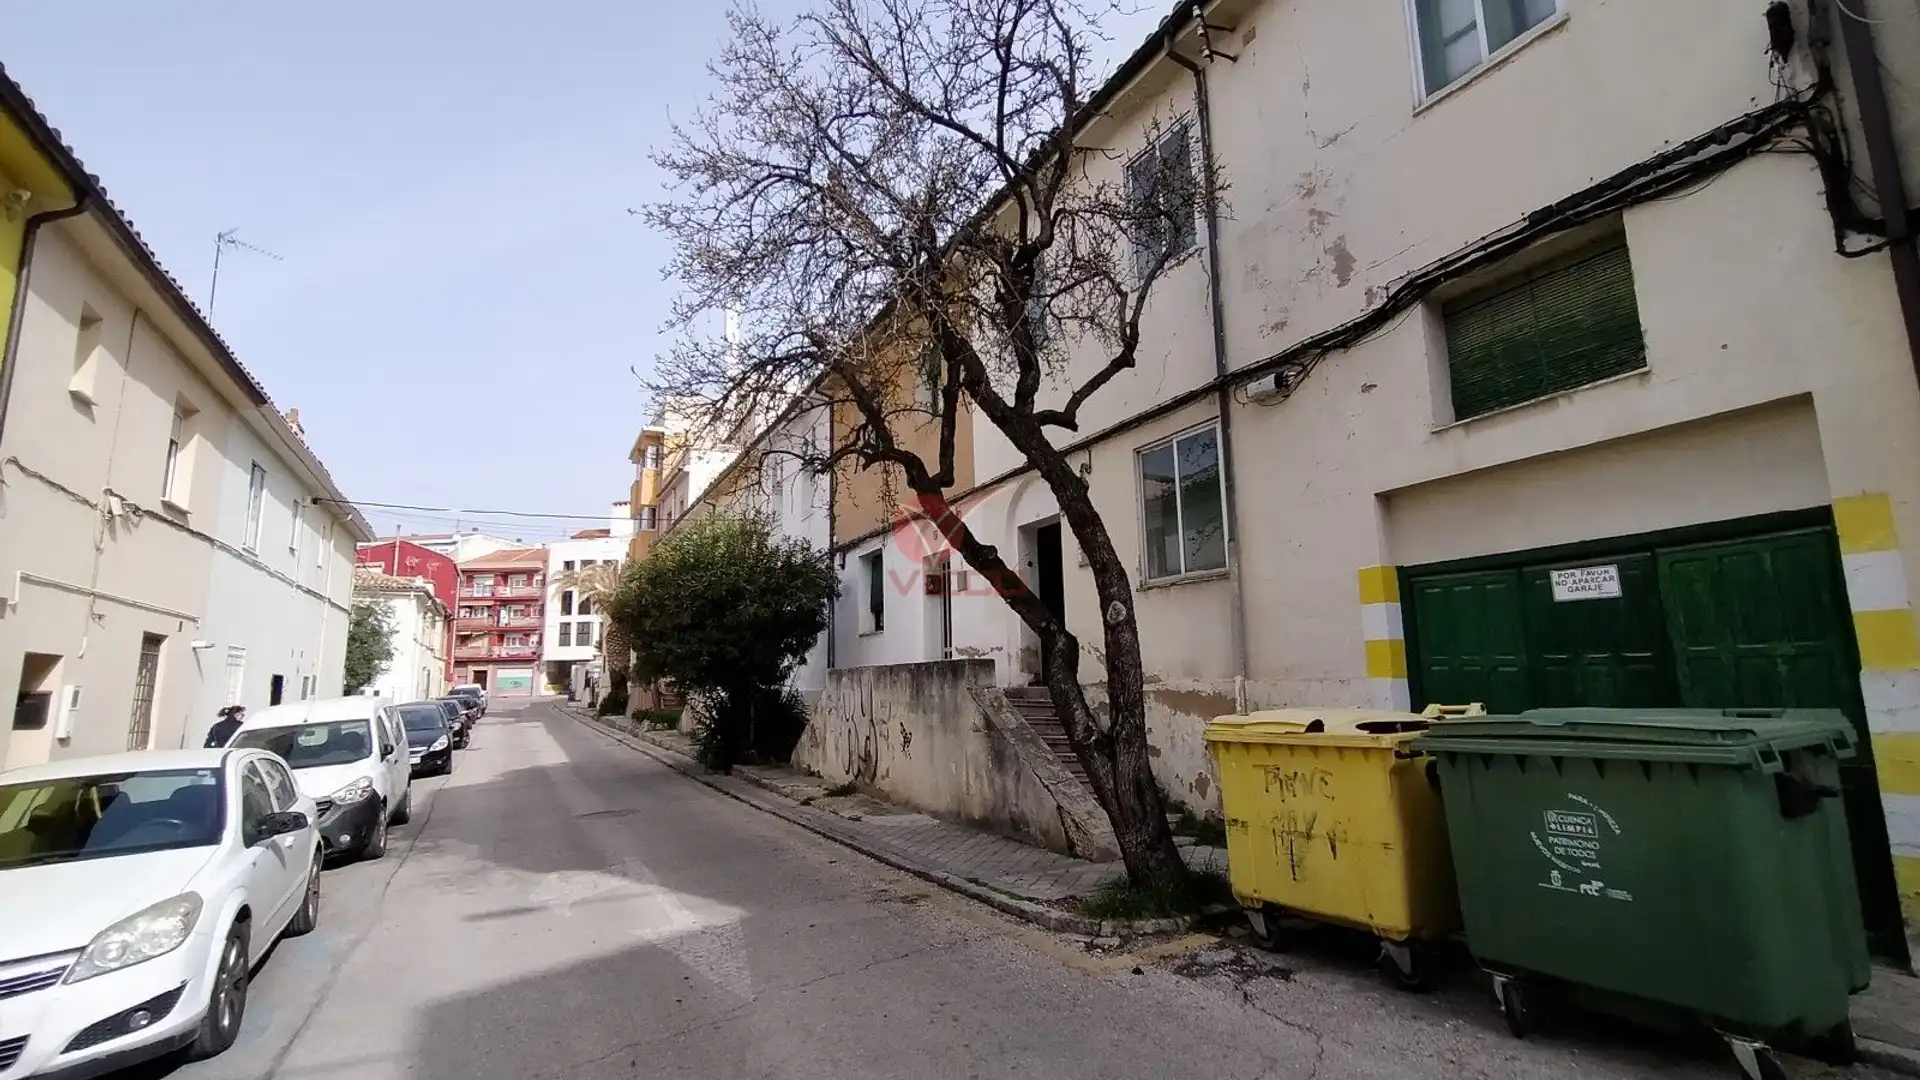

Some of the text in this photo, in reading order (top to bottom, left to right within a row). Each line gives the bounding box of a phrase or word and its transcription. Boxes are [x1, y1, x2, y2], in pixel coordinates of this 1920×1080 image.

[1580, 568, 1610, 577] FAVOR
[1555, 575, 1616, 587] NO APARCAR
[1567, 584, 1604, 592] GARAJE
[1557, 814, 1593, 826] CUENCA
[1554, 846, 1597, 859] DE TODOS
